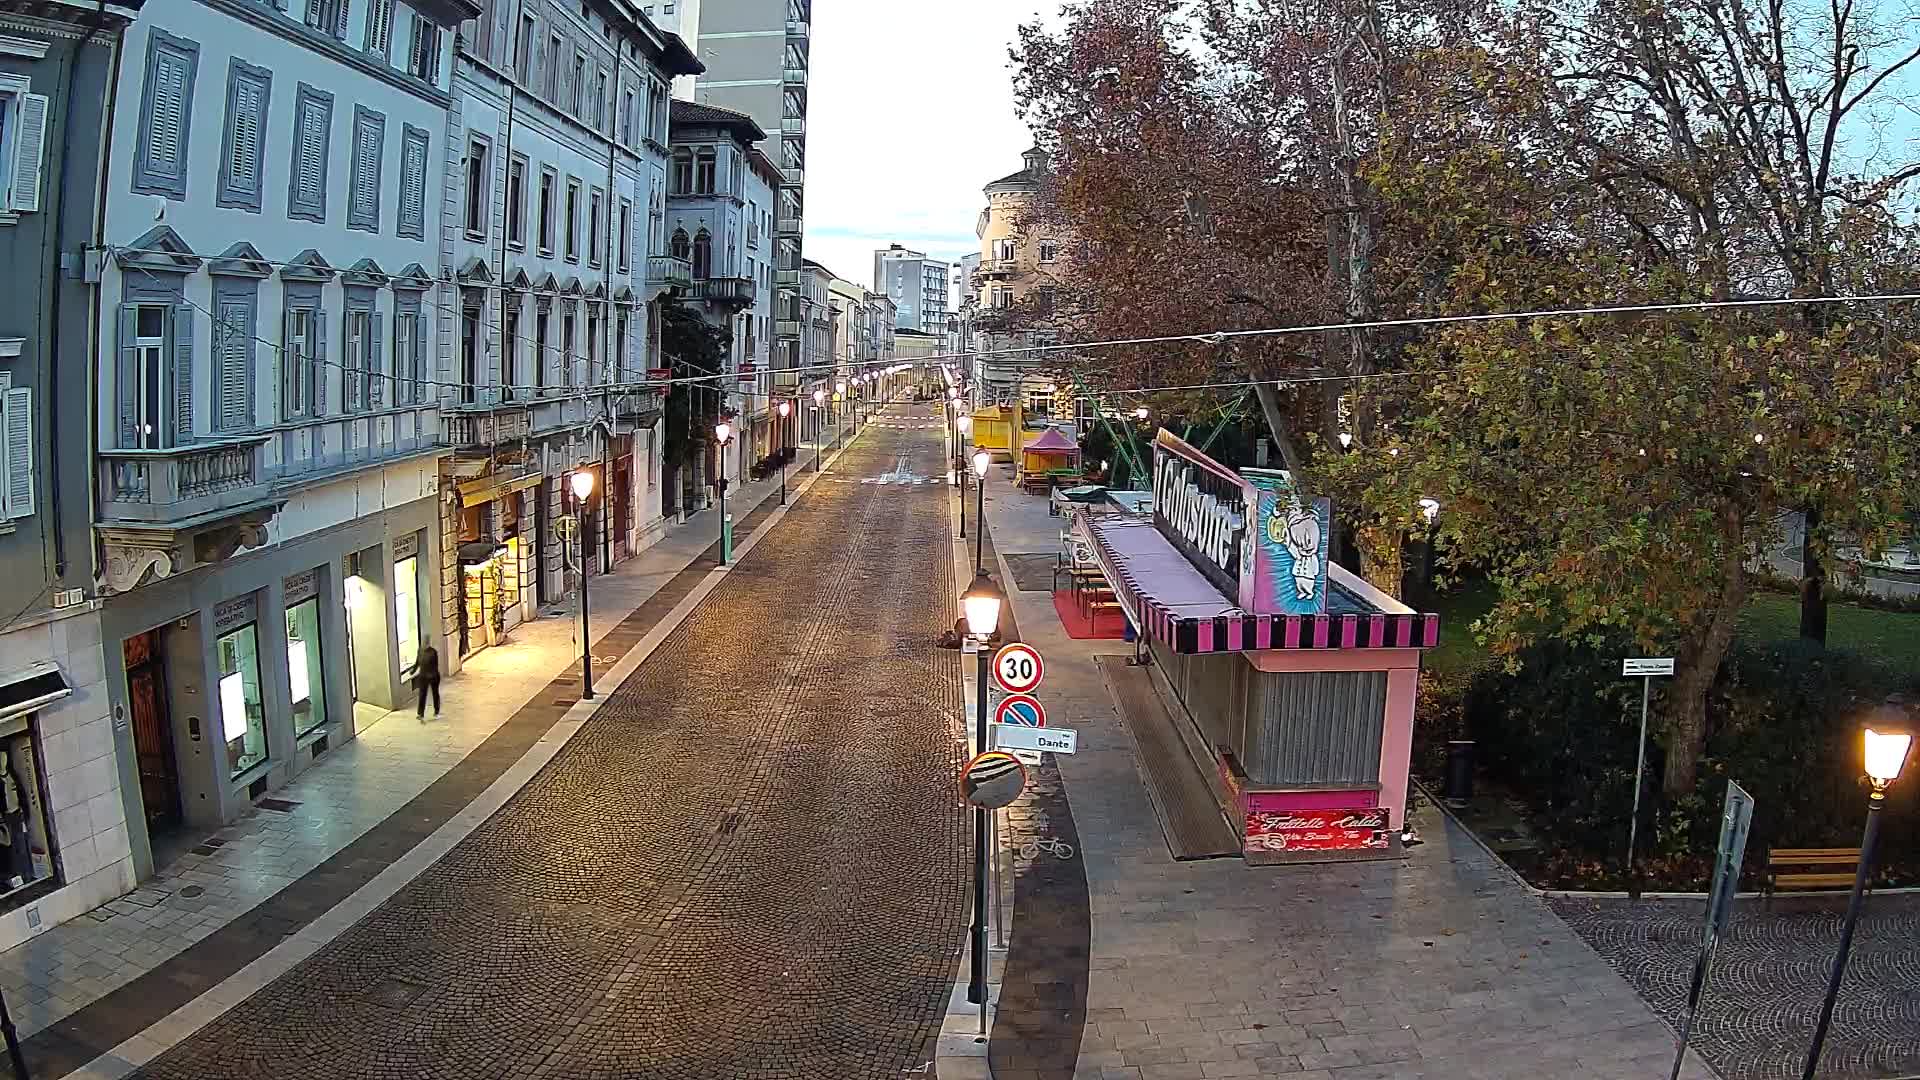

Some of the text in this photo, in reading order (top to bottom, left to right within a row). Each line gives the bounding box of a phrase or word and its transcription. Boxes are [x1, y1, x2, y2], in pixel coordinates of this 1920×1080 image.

[1162, 458, 1233, 570] Golosone
[1006, 658, 1033, 680] 30
[1038, 737, 1070, 748] Dante
